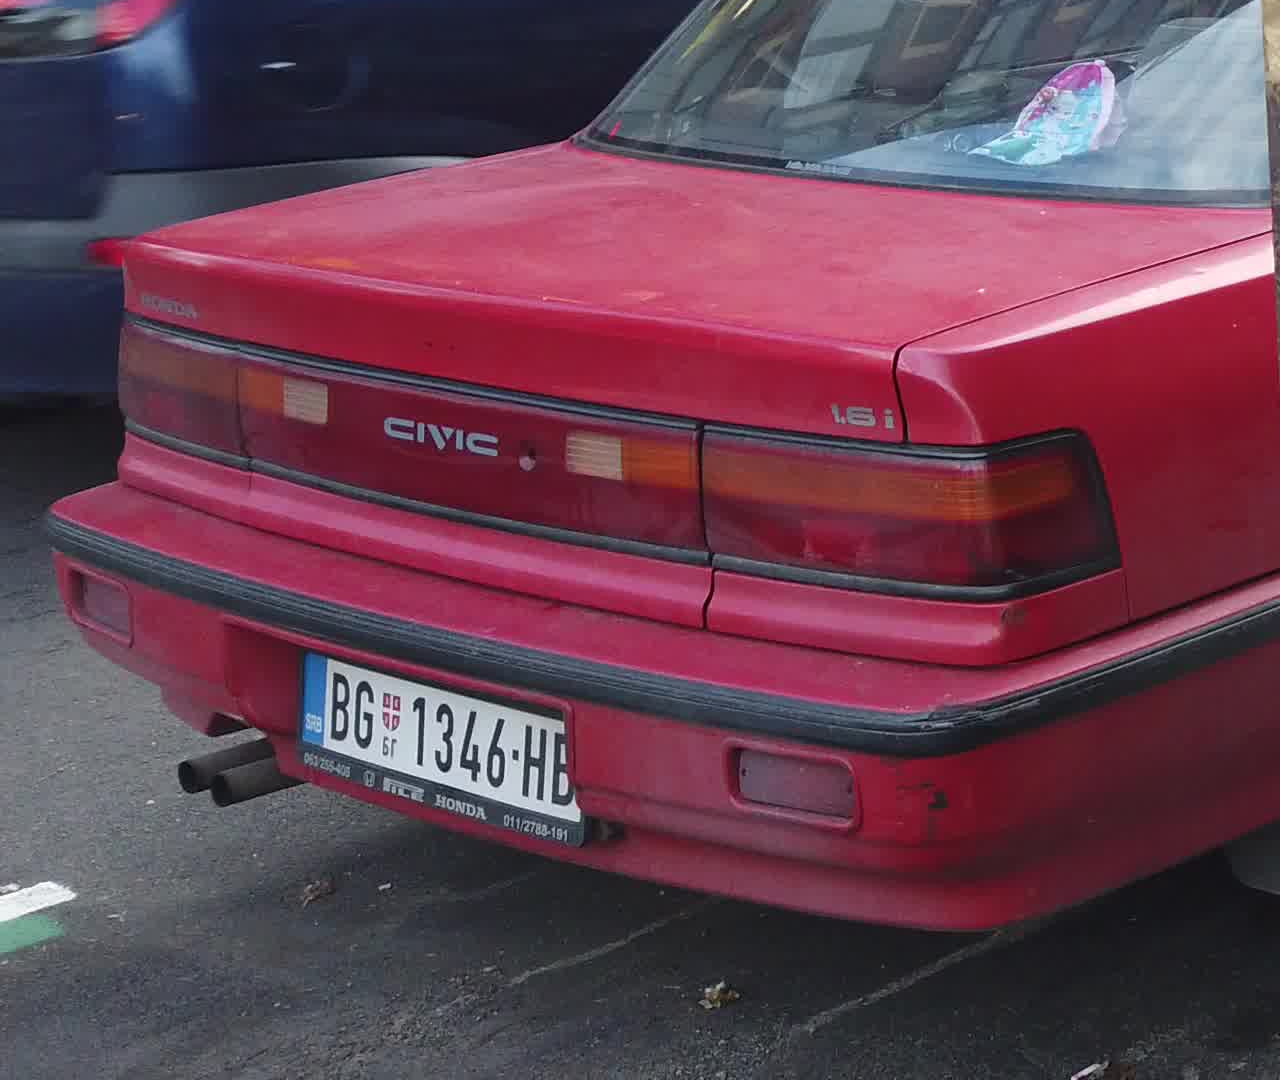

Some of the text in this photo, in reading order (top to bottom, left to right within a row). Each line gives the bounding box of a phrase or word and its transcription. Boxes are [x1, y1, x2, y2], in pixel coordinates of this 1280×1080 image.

[383, 416, 499, 457] CIVIC
[330, 671, 375, 749] BG
[434, 793, 488, 821] HONDA
